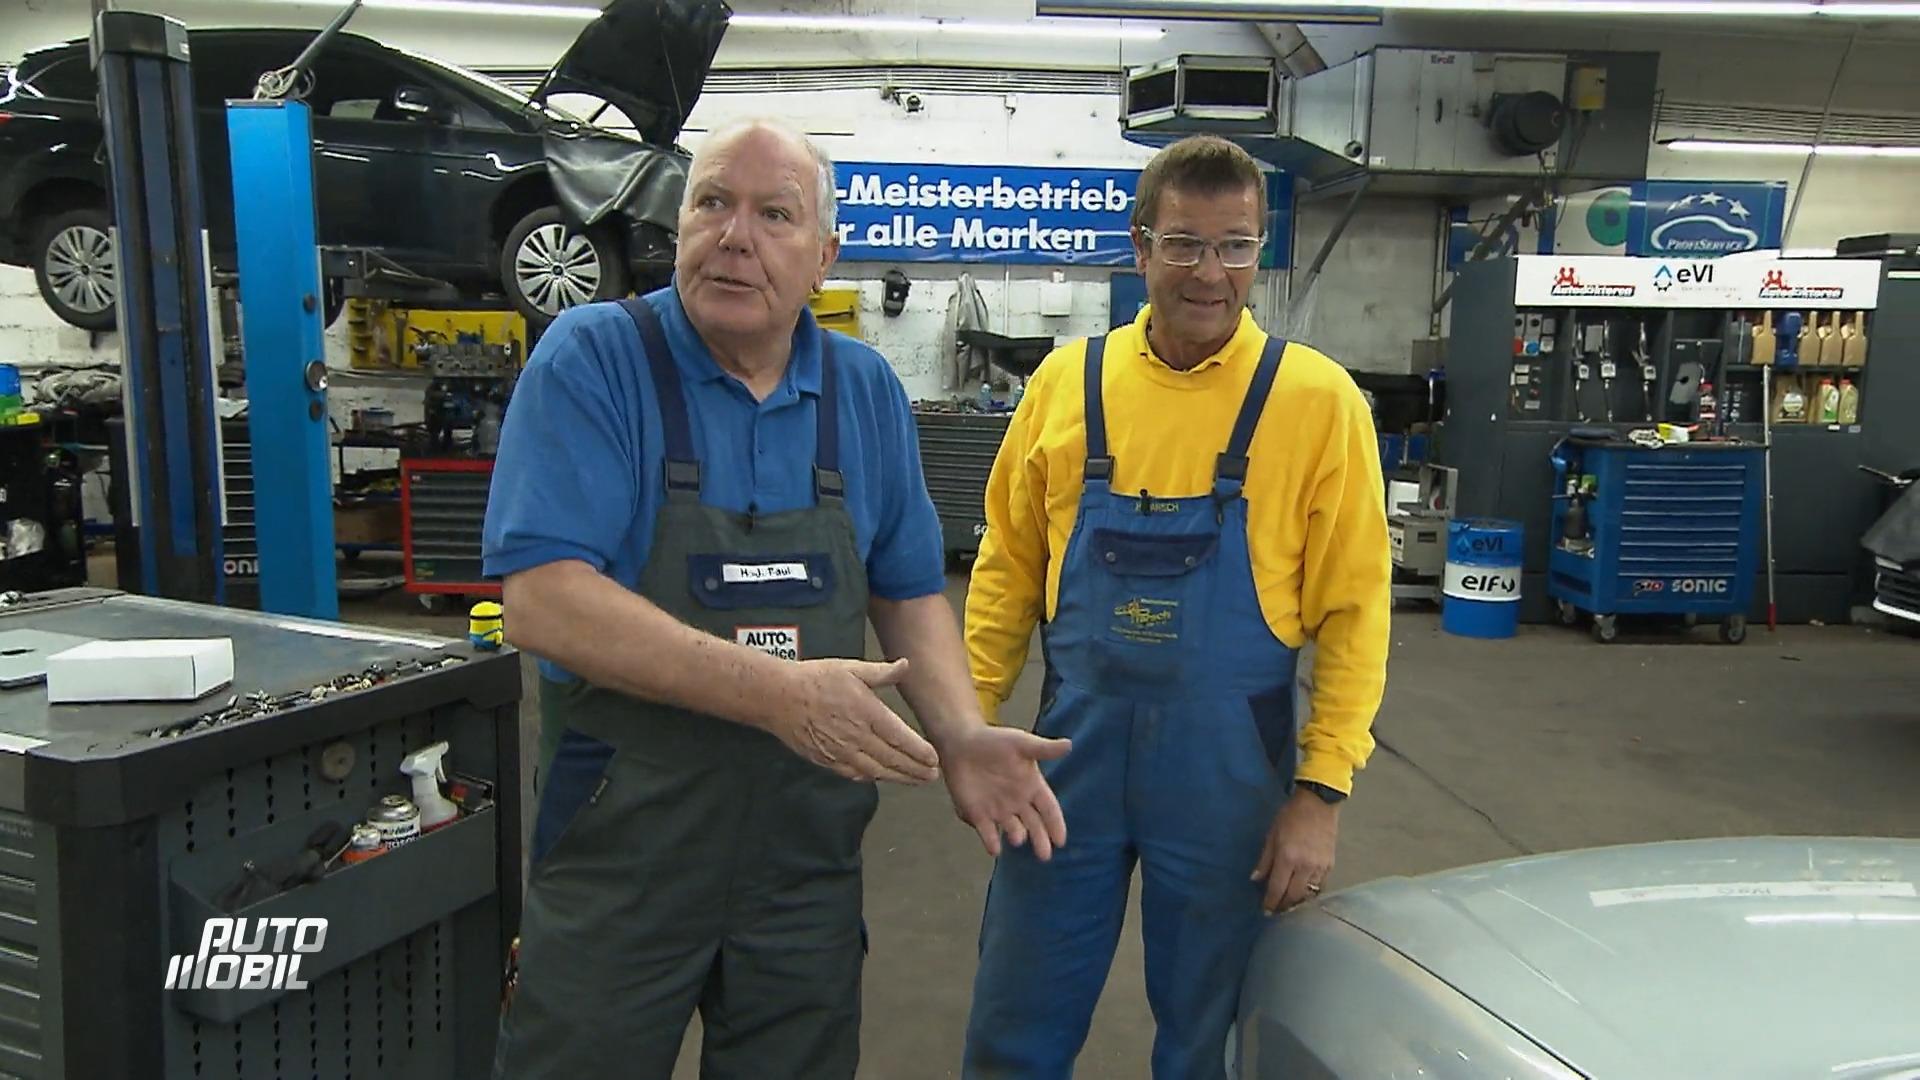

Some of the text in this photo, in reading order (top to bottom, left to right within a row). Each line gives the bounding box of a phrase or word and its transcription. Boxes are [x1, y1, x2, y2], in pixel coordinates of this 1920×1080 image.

[866, 215, 938, 248] alle
[951, 217, 1096, 250] Marken
[1461, 575, 1501, 592] elf
[745, 632, 793, 647] AUTO-
